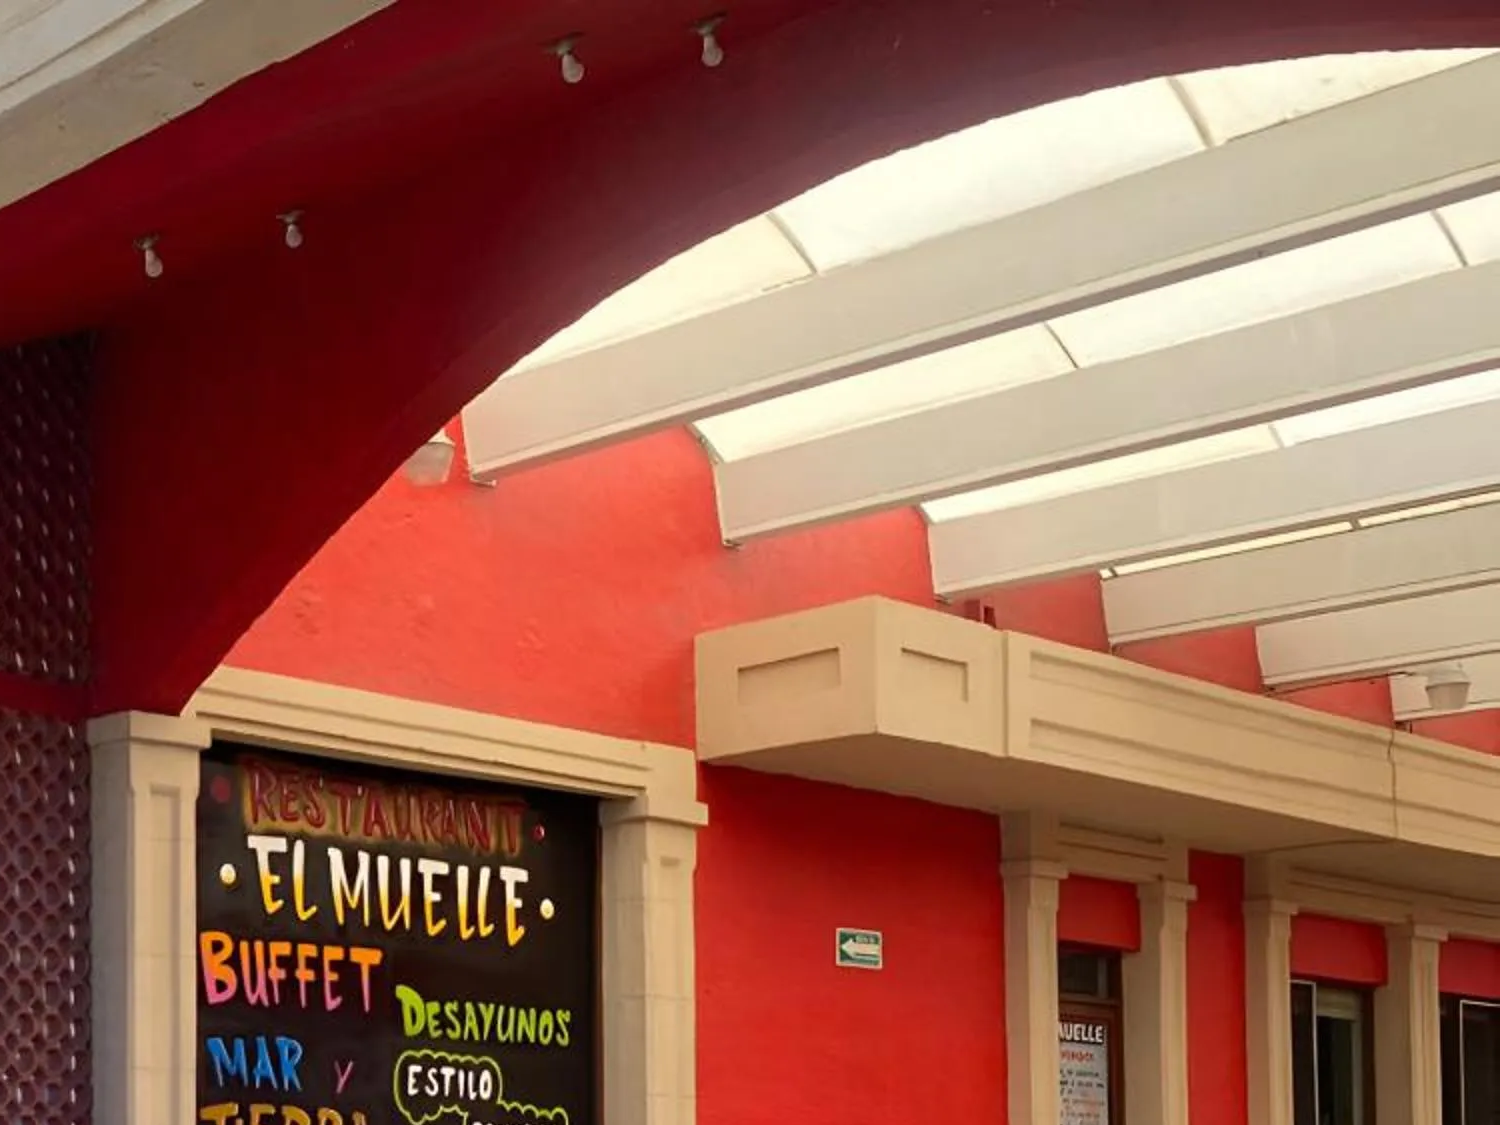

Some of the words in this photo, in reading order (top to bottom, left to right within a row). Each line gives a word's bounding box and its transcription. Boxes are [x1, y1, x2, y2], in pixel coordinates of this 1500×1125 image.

[242, 758, 529, 854] RESTAURANT
[247, 835, 317, 921] EL
[327, 847, 529, 947] MUELLE
[200, 931, 383, 1012] BUFFET
[395, 985, 571, 1046] DESAYUNOS
[207, 1036, 303, 1092] MAR
[407, 1065, 493, 1100] ESTILO
